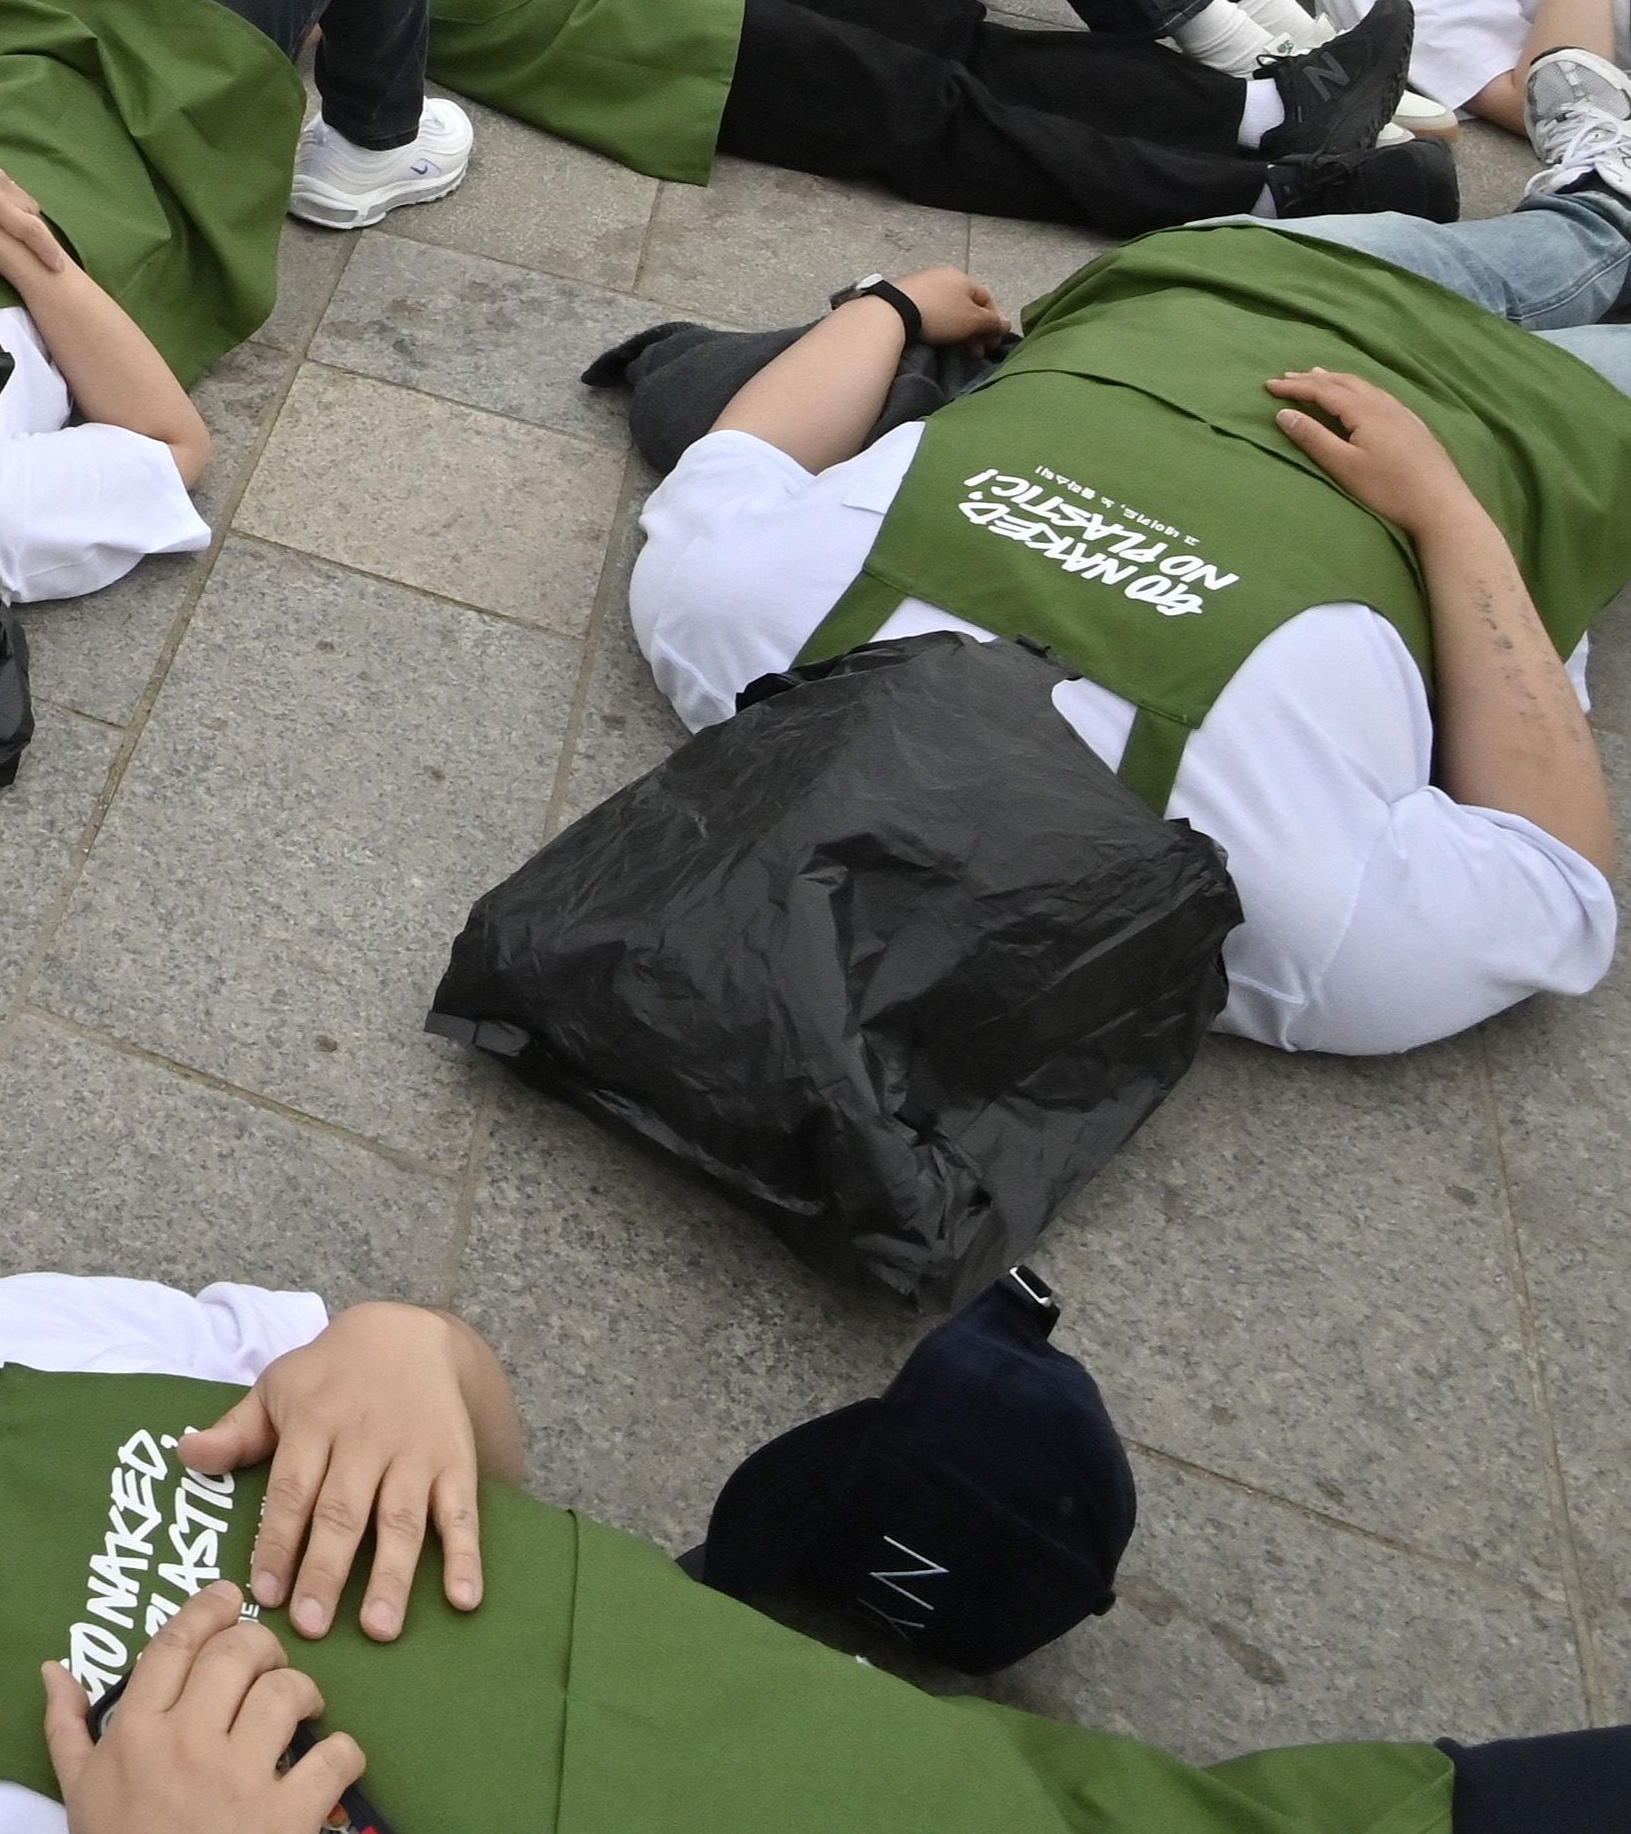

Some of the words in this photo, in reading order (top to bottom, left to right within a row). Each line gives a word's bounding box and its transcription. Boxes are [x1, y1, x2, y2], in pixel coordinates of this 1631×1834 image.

[1303, 52, 1350, 100] N
[964, 468, 1162, 561] PLASTIC!
[1102, 495, 1117, 510] 노
[959, 492, 1139, 587] NAKED,
[1184, 536, 1201, 548] 고
[1157, 554, 1239, 590] NO
[1124, 575, 1203, 616] GO
[86, 1428, 180, 1629] NAKED,
